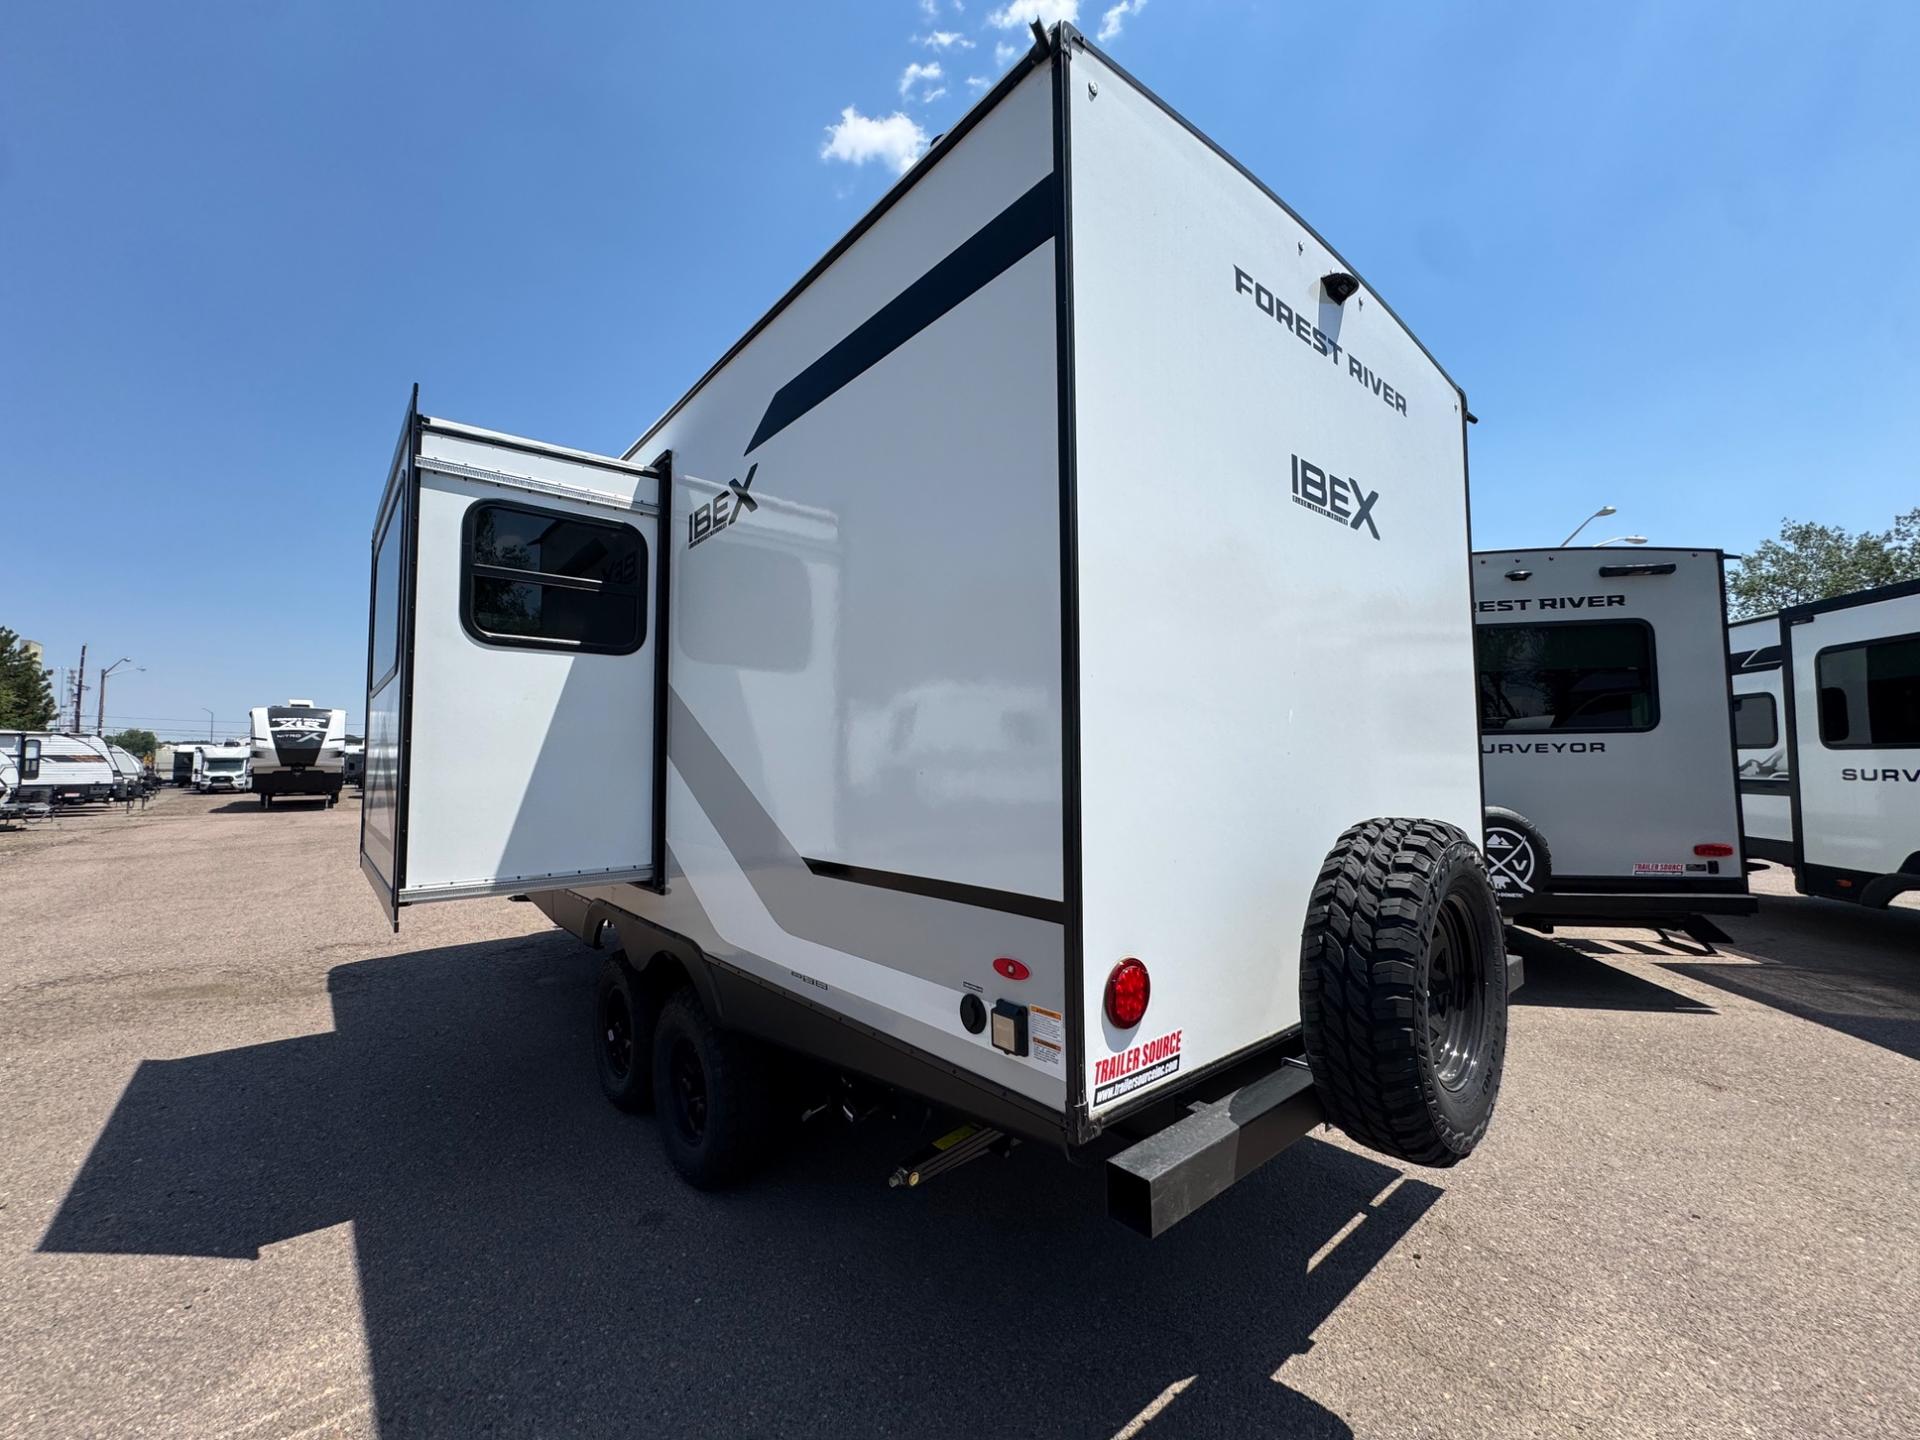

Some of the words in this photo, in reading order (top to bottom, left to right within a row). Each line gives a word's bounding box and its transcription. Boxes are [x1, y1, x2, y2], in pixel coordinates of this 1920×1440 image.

[1233, 264, 1343, 366] FOREST
[1347, 353, 1408, 418] RIVER
[688, 462, 759, 544] IBEX
[1291, 453, 1381, 541] IBEX
[1474, 599, 1532, 612] EST
[1538, 595, 1626, 610] RIVER
[1842, 768, 1920, 782] SURV
[1094, 1046, 1141, 1086] TRAILER
[1141, 1029, 1182, 1067] SOURCE
